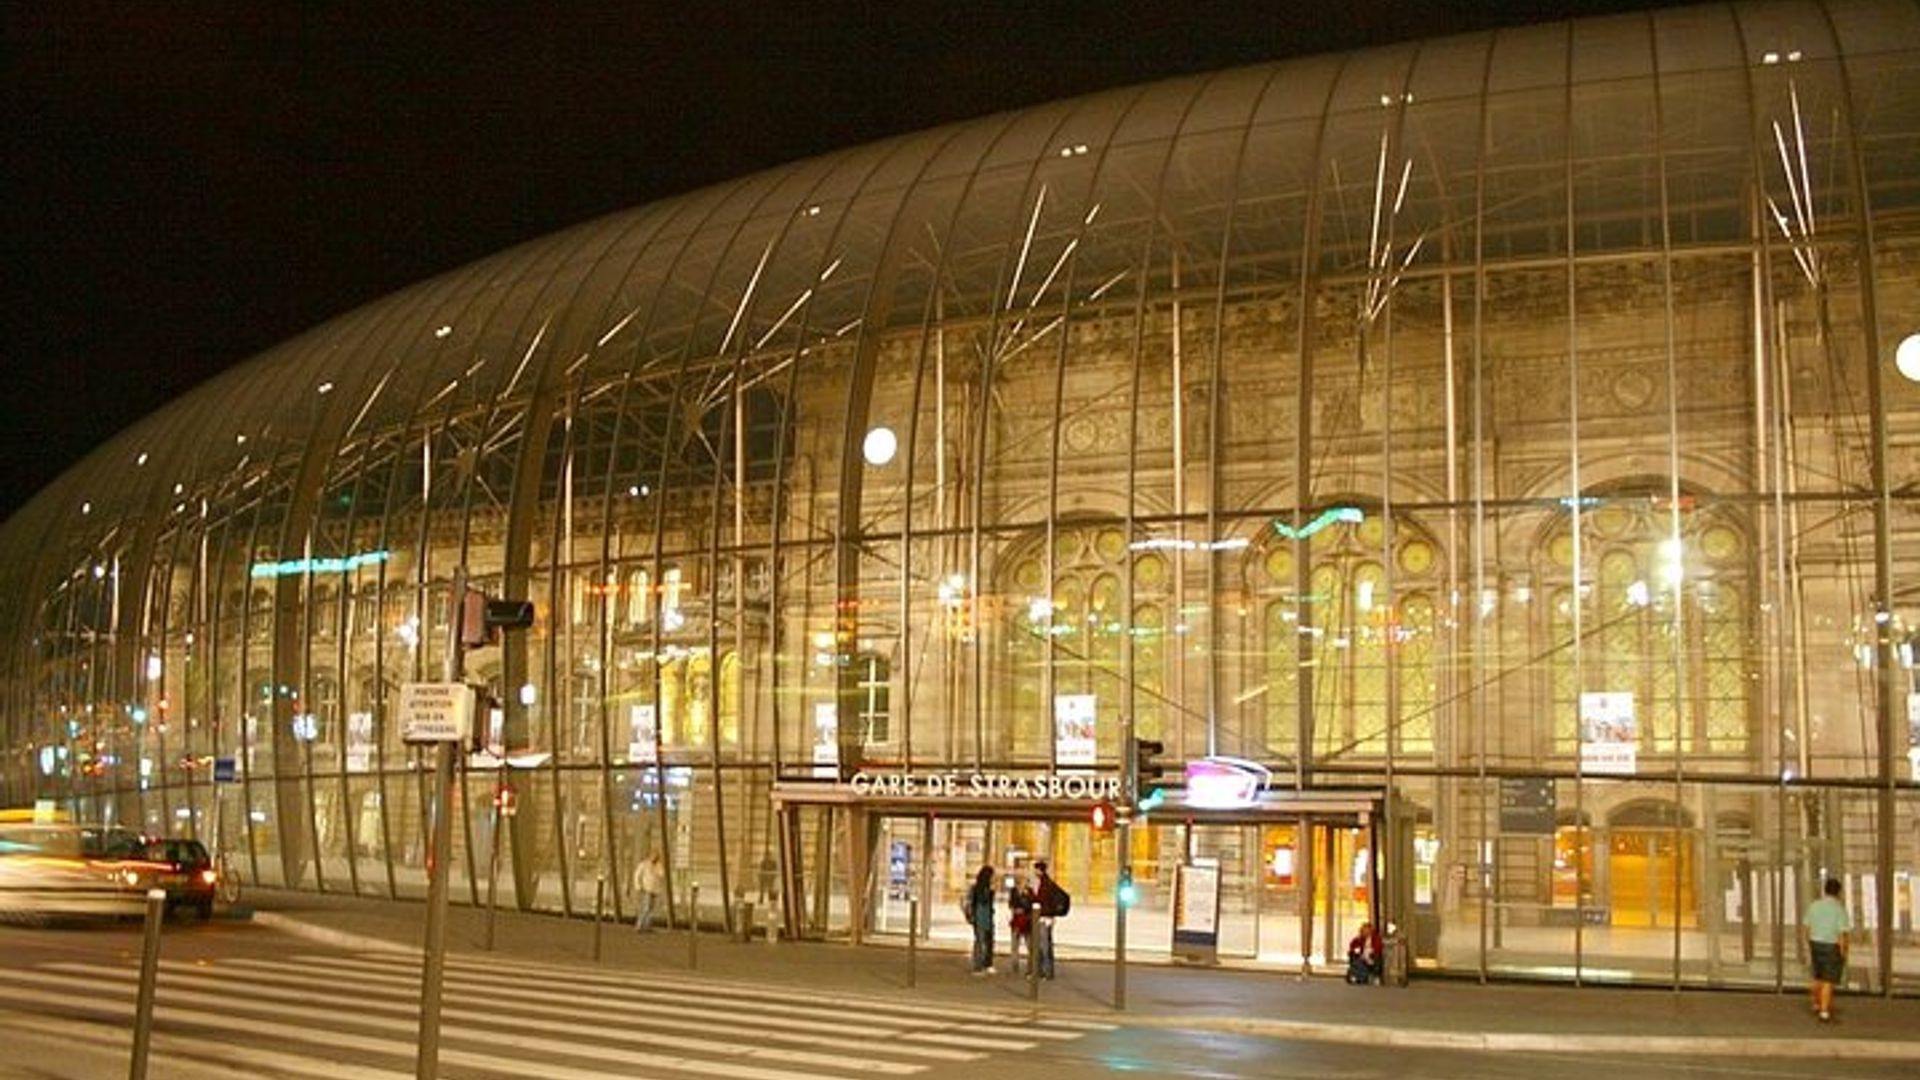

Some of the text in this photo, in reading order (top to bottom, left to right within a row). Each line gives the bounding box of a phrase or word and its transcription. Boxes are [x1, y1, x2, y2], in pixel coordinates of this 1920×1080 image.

[851, 772, 1121, 800] GARE DE STRASBOUR
